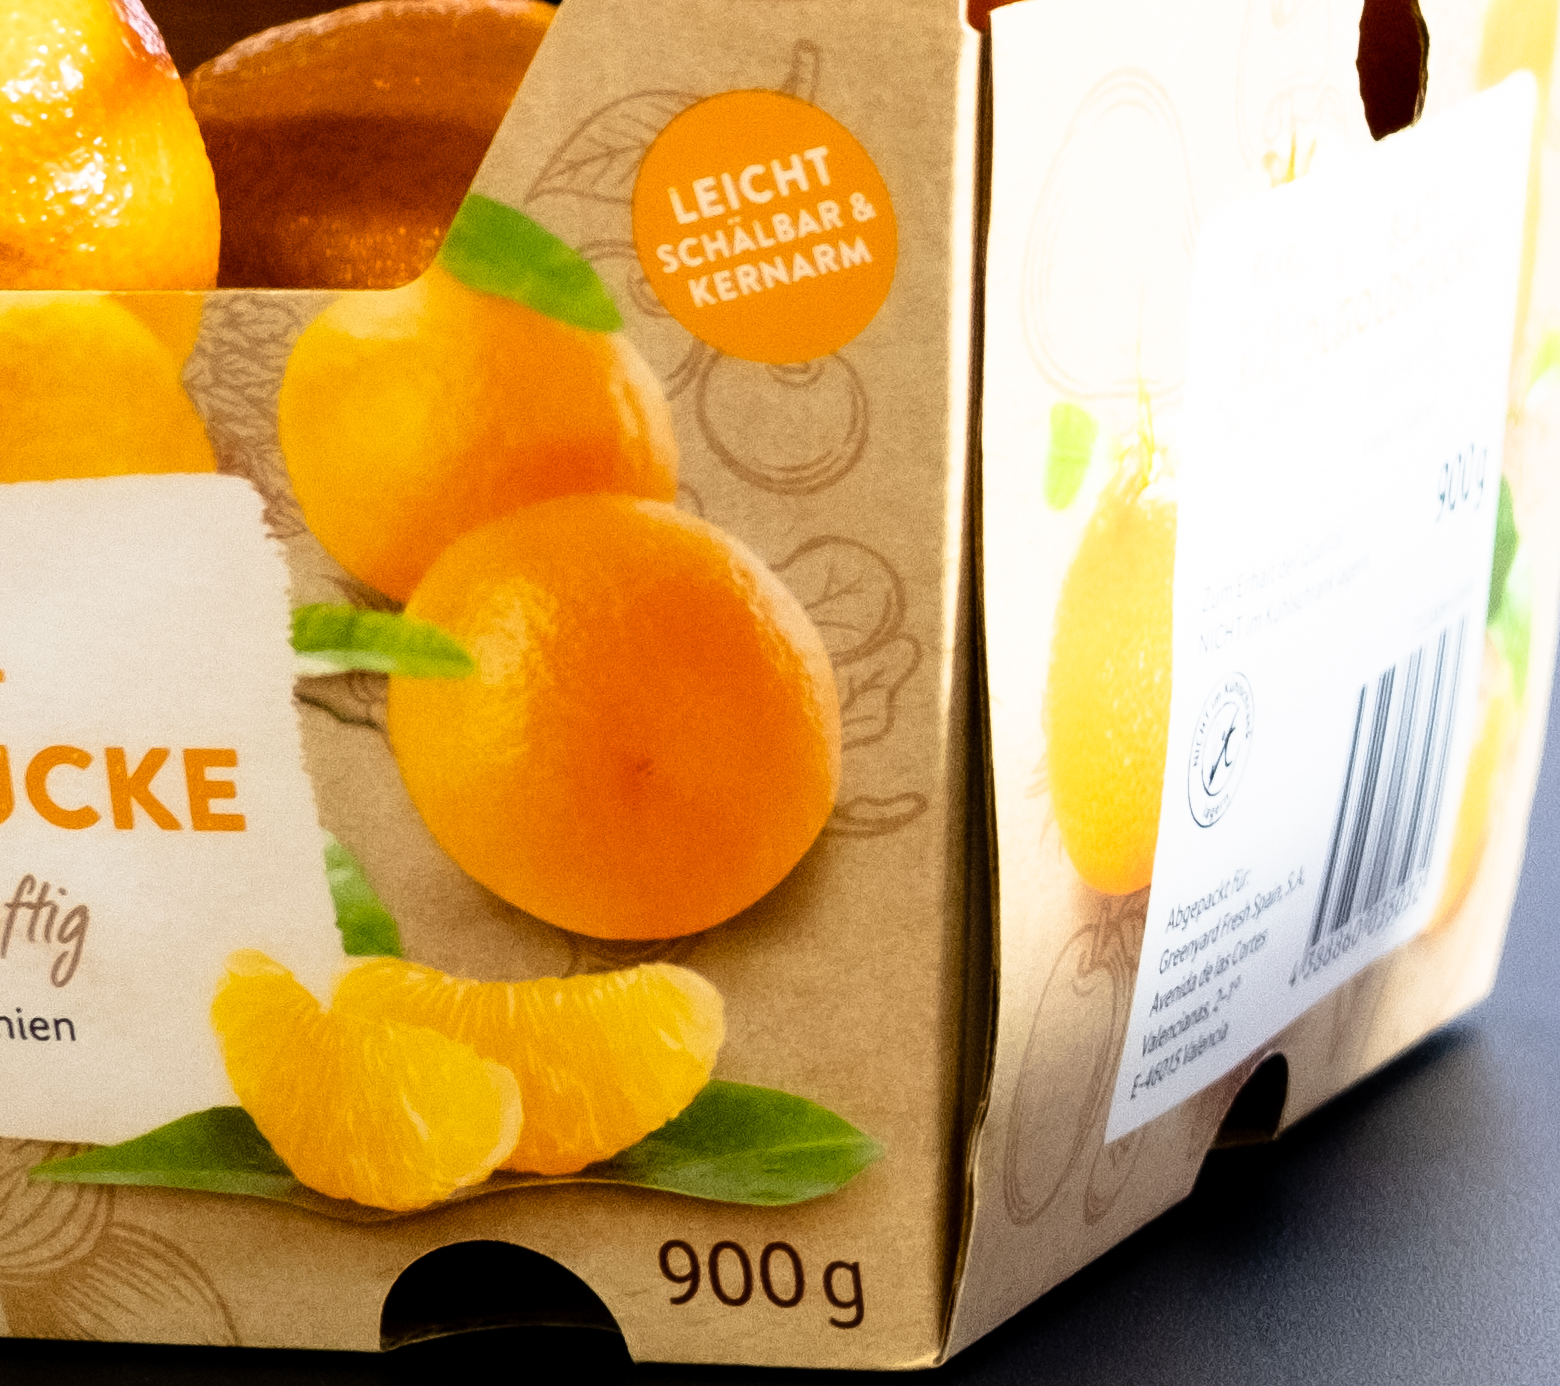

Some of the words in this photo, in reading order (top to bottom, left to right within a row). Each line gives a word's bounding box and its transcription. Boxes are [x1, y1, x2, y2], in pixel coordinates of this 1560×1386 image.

[668, 146, 831, 225] LEICHT
[656, 199, 844, 274] SCHÄLBAR
[849, 191, 877, 222] &
[688, 235, 874, 308] KERNARM
[0, 744, 247, 832] CKE
[1165, 879, 1231, 933] Abgepackt
[1159, 916, 1221, 975] Greenyard
